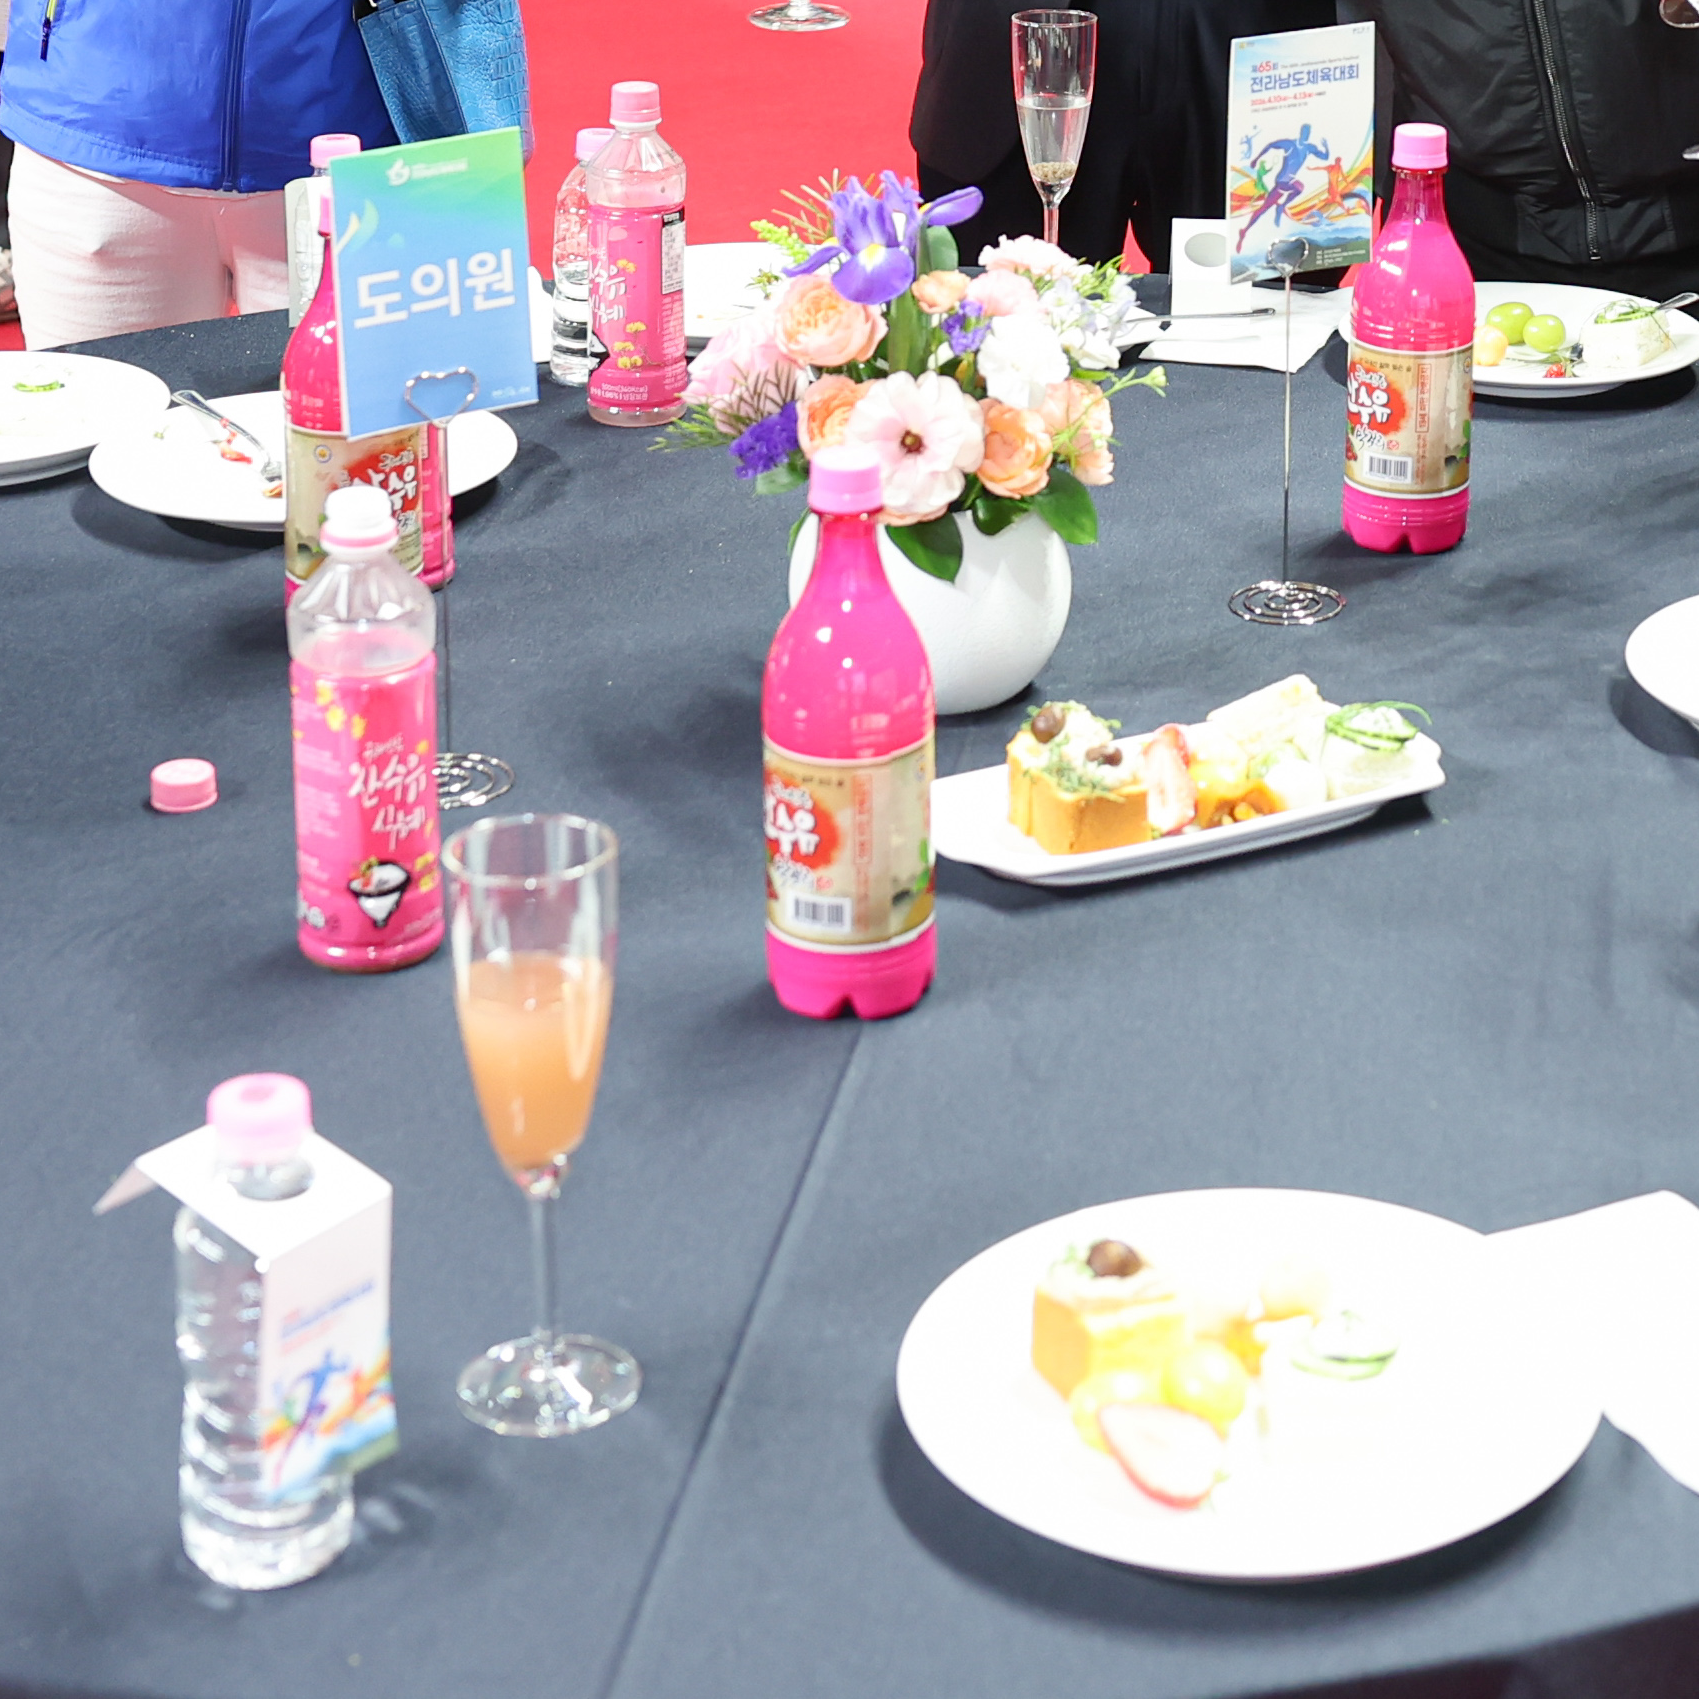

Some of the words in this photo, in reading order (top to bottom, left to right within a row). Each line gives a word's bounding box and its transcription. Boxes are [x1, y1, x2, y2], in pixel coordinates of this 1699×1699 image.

[1250, 63, 1360, 94] 전라남도체육대회
[353, 247, 517, 330] 도의원
[588, 259, 627, 301] 수유
[1354, 424, 1386, 451] 막걸리
